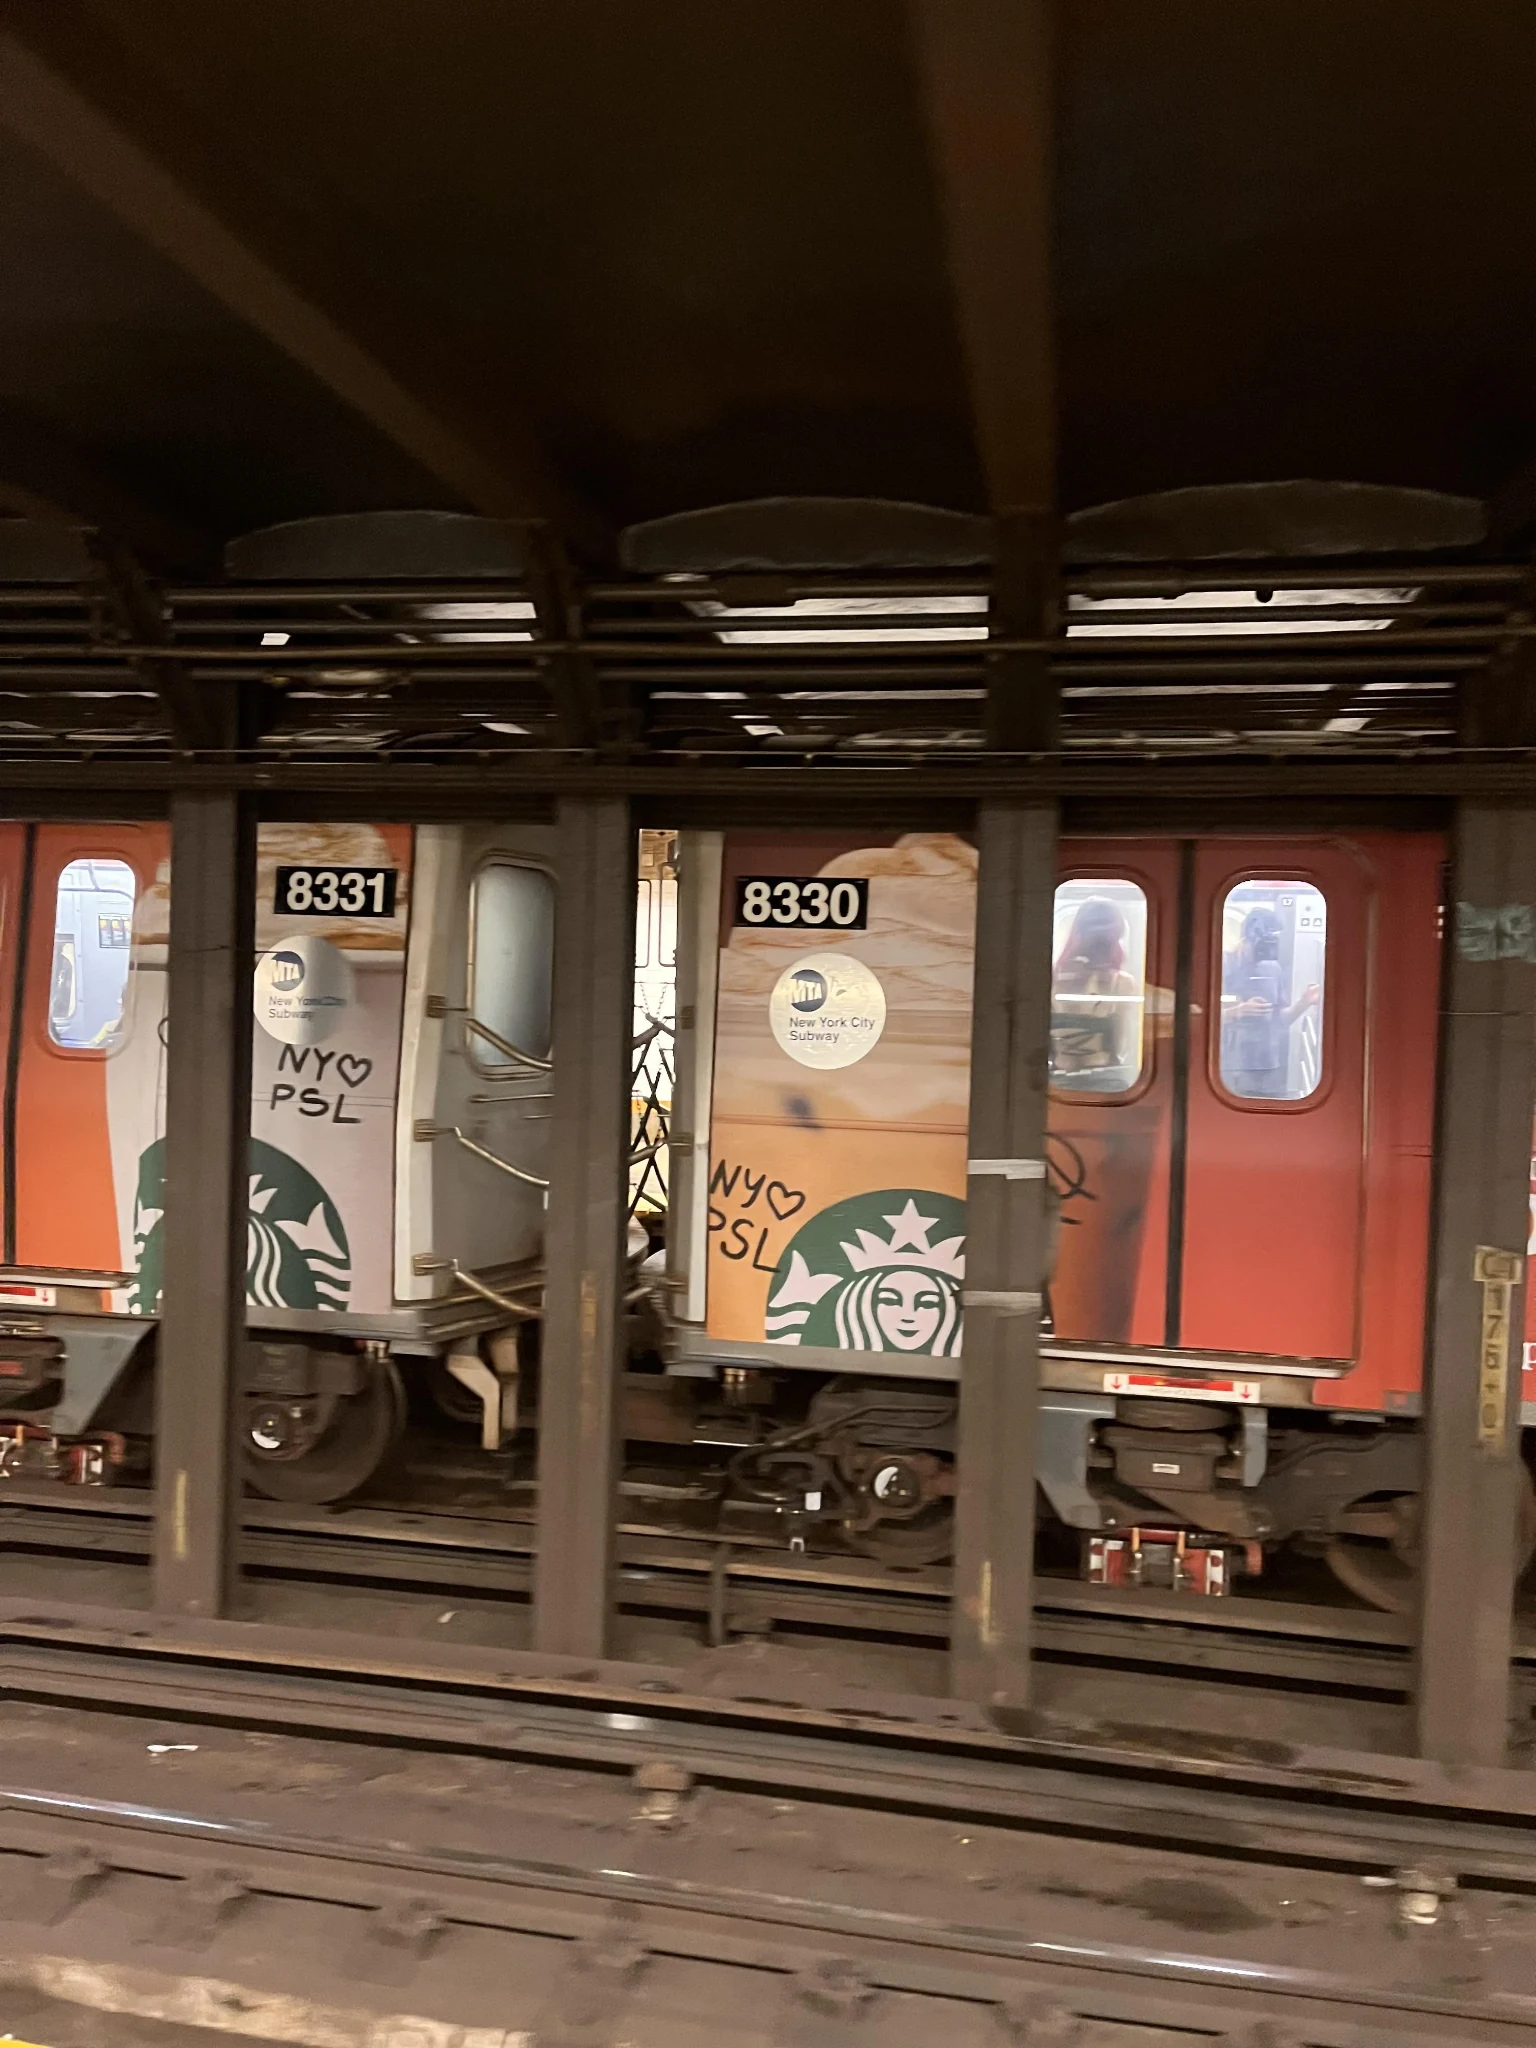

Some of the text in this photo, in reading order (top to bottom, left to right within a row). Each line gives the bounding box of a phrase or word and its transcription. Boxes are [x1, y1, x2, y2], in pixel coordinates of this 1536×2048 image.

[286, 871, 385, 913] 8331
[742, 881, 860, 925] 8330
[268, 995, 293, 1006] New
[789, 978, 823, 1004] MTA
[789, 1017, 876, 1031] New York City
[789, 1030, 839, 1044] Subway
[278, 1043, 336, 1082] NY
[269, 1083, 362, 1124] PSL
[707, 1206, 782, 1274] PSL
